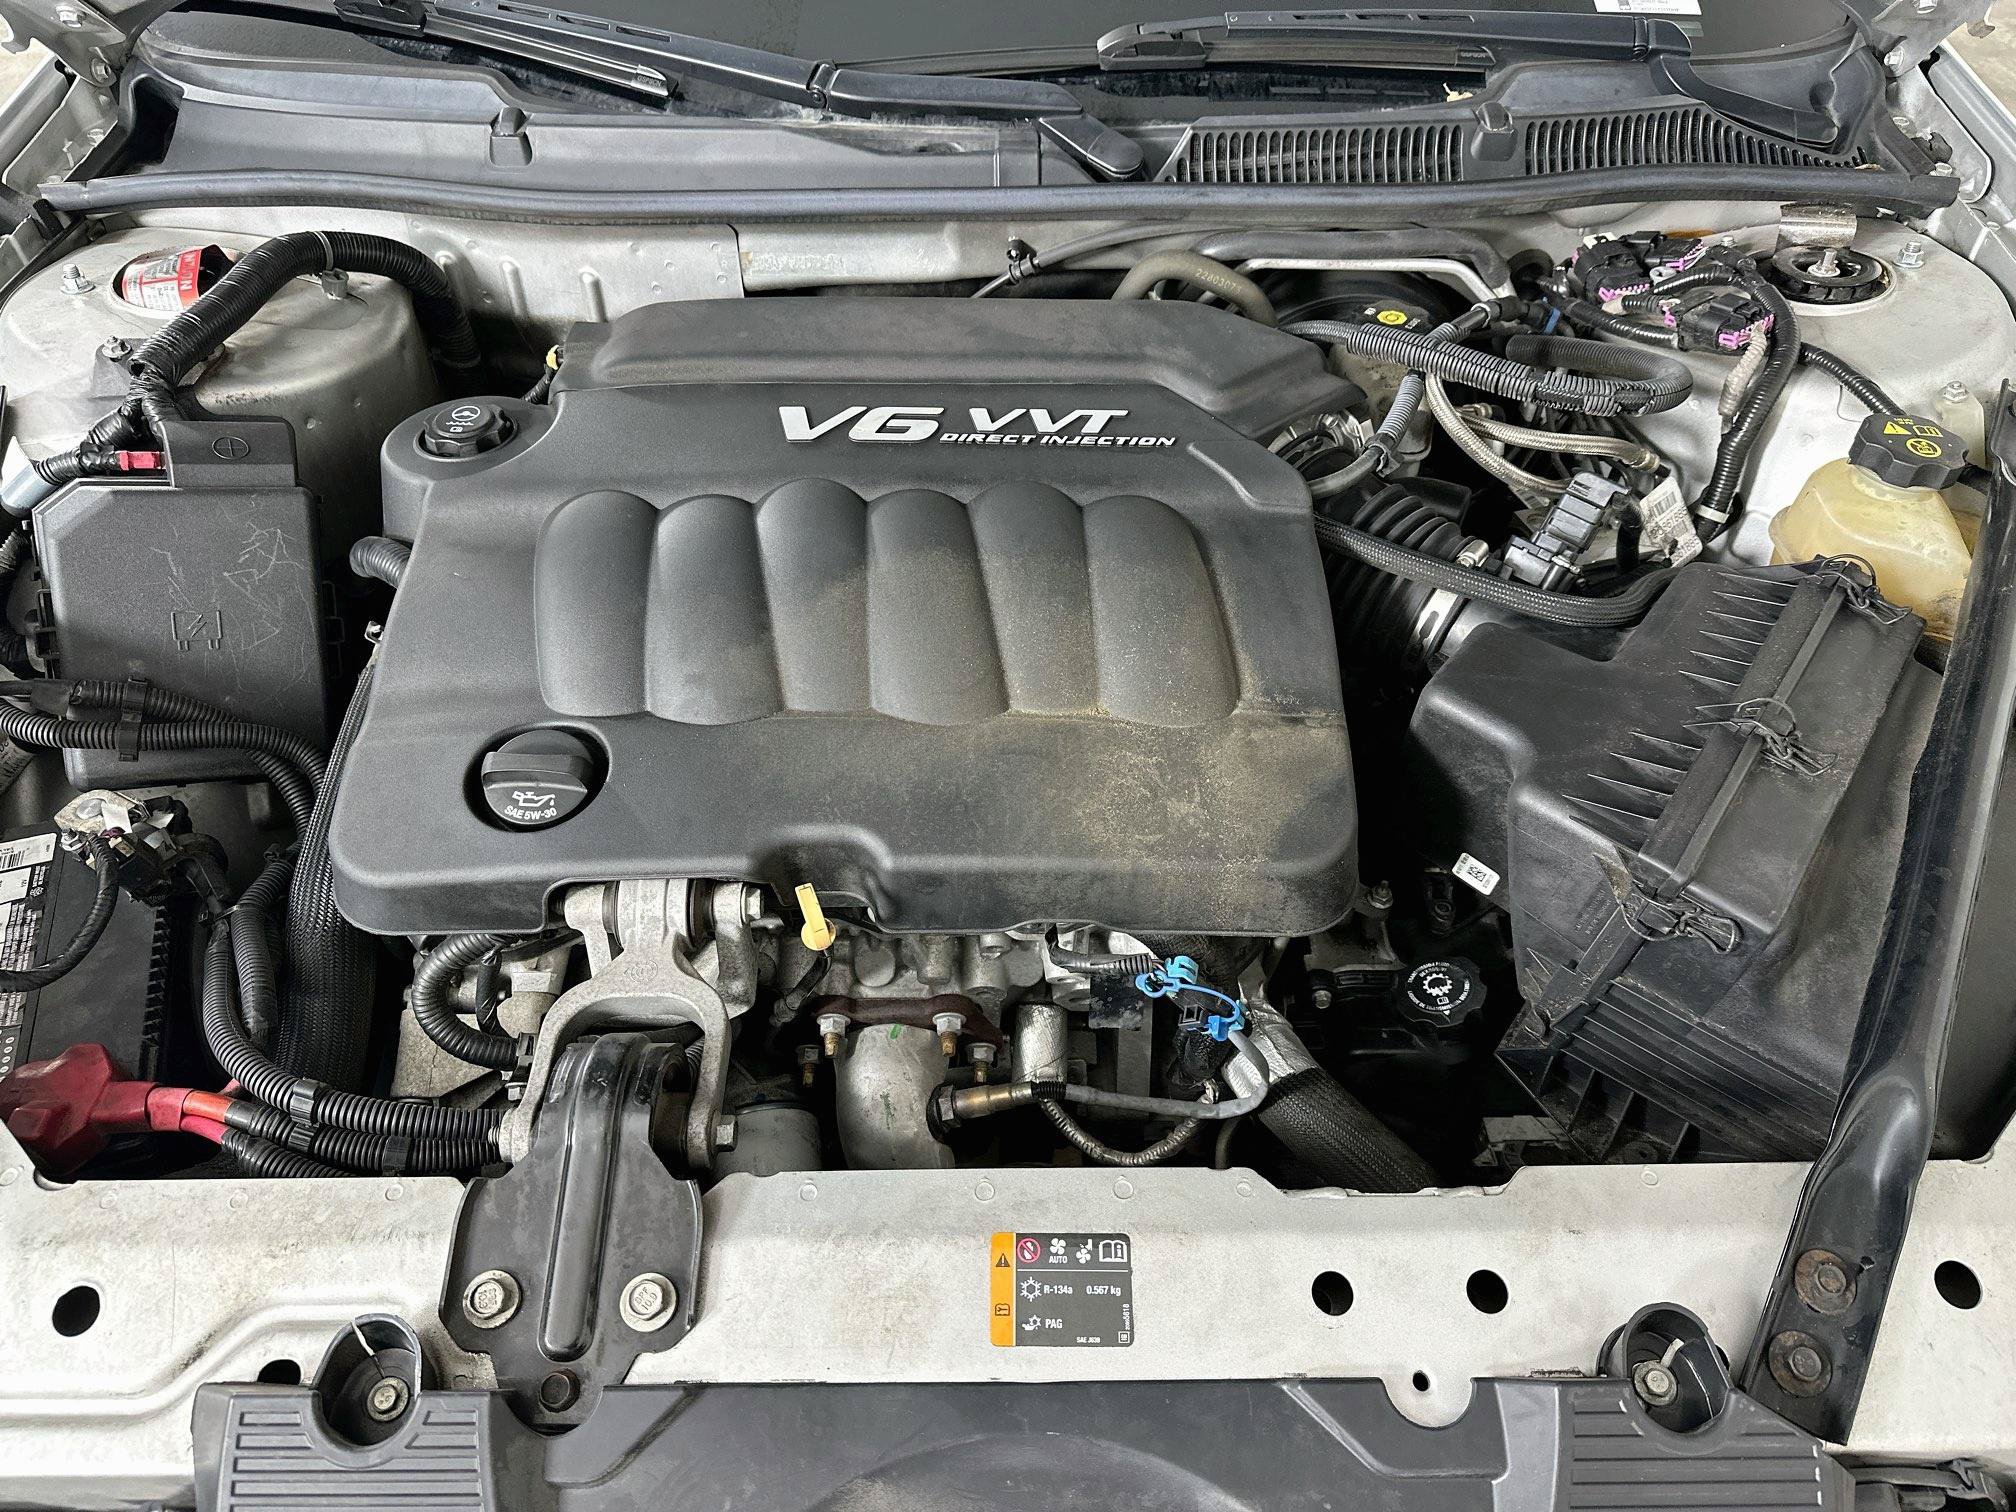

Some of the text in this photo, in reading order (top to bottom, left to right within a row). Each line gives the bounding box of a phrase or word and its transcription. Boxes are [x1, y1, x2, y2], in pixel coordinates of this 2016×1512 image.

[779, 406, 1129, 443] V6 VVT
[939, 432, 1176, 448] DIRECT INJECTION
[504, 805, 557, 820] SAE 5W-30
[1049, 1255, 1068, 1264] AUTO
[1043, 1285, 1122, 1297] R-134a 0.567 kg
[1045, 1318, 1063, 1329] PAG
